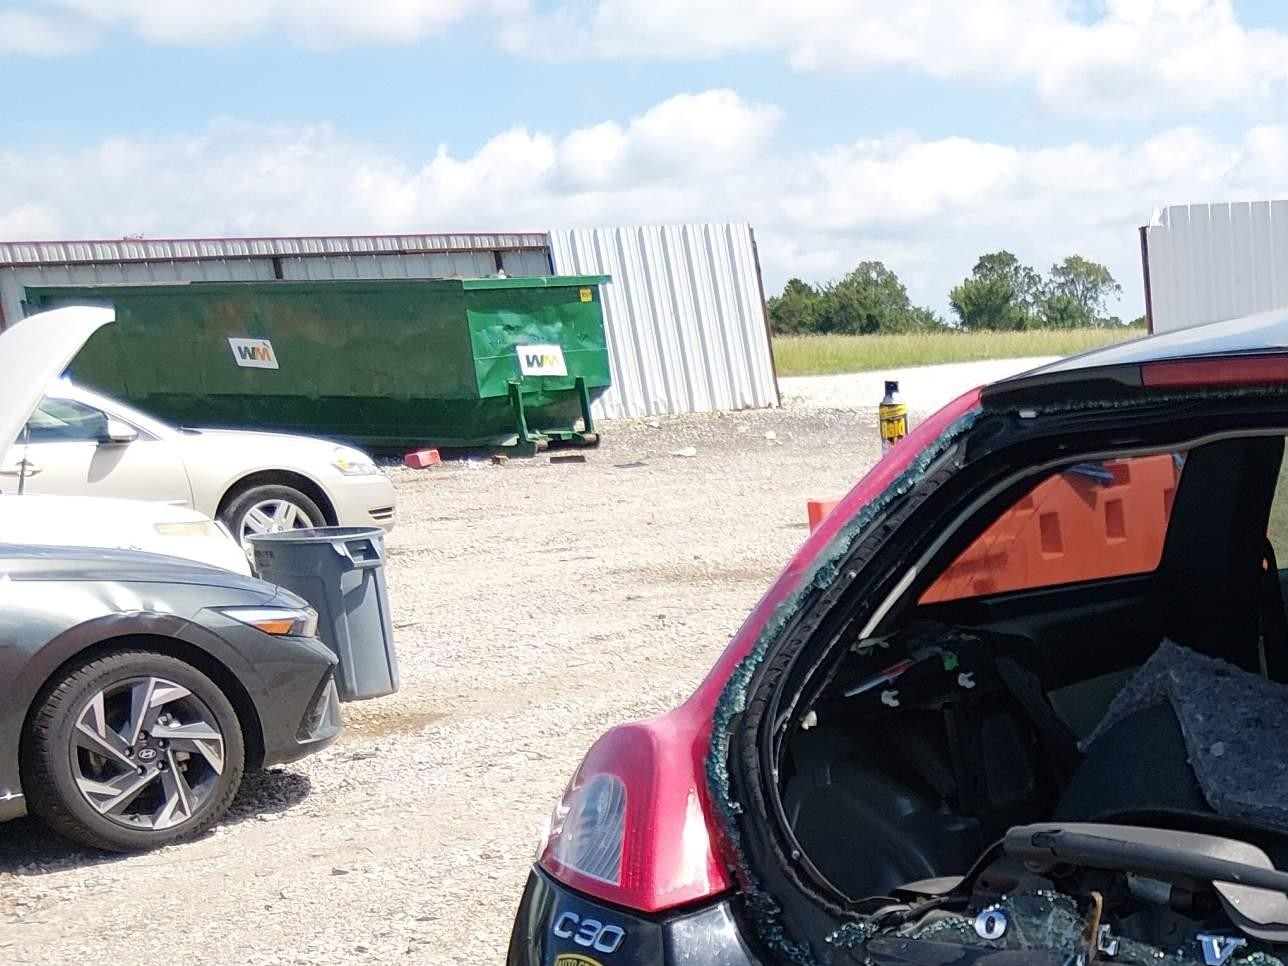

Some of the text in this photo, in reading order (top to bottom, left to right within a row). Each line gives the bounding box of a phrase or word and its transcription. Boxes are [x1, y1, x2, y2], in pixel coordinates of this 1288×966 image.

[237, 346, 272, 361] WM
[525, 354, 559, 368] WM
[553, 911, 626, 953] C30
